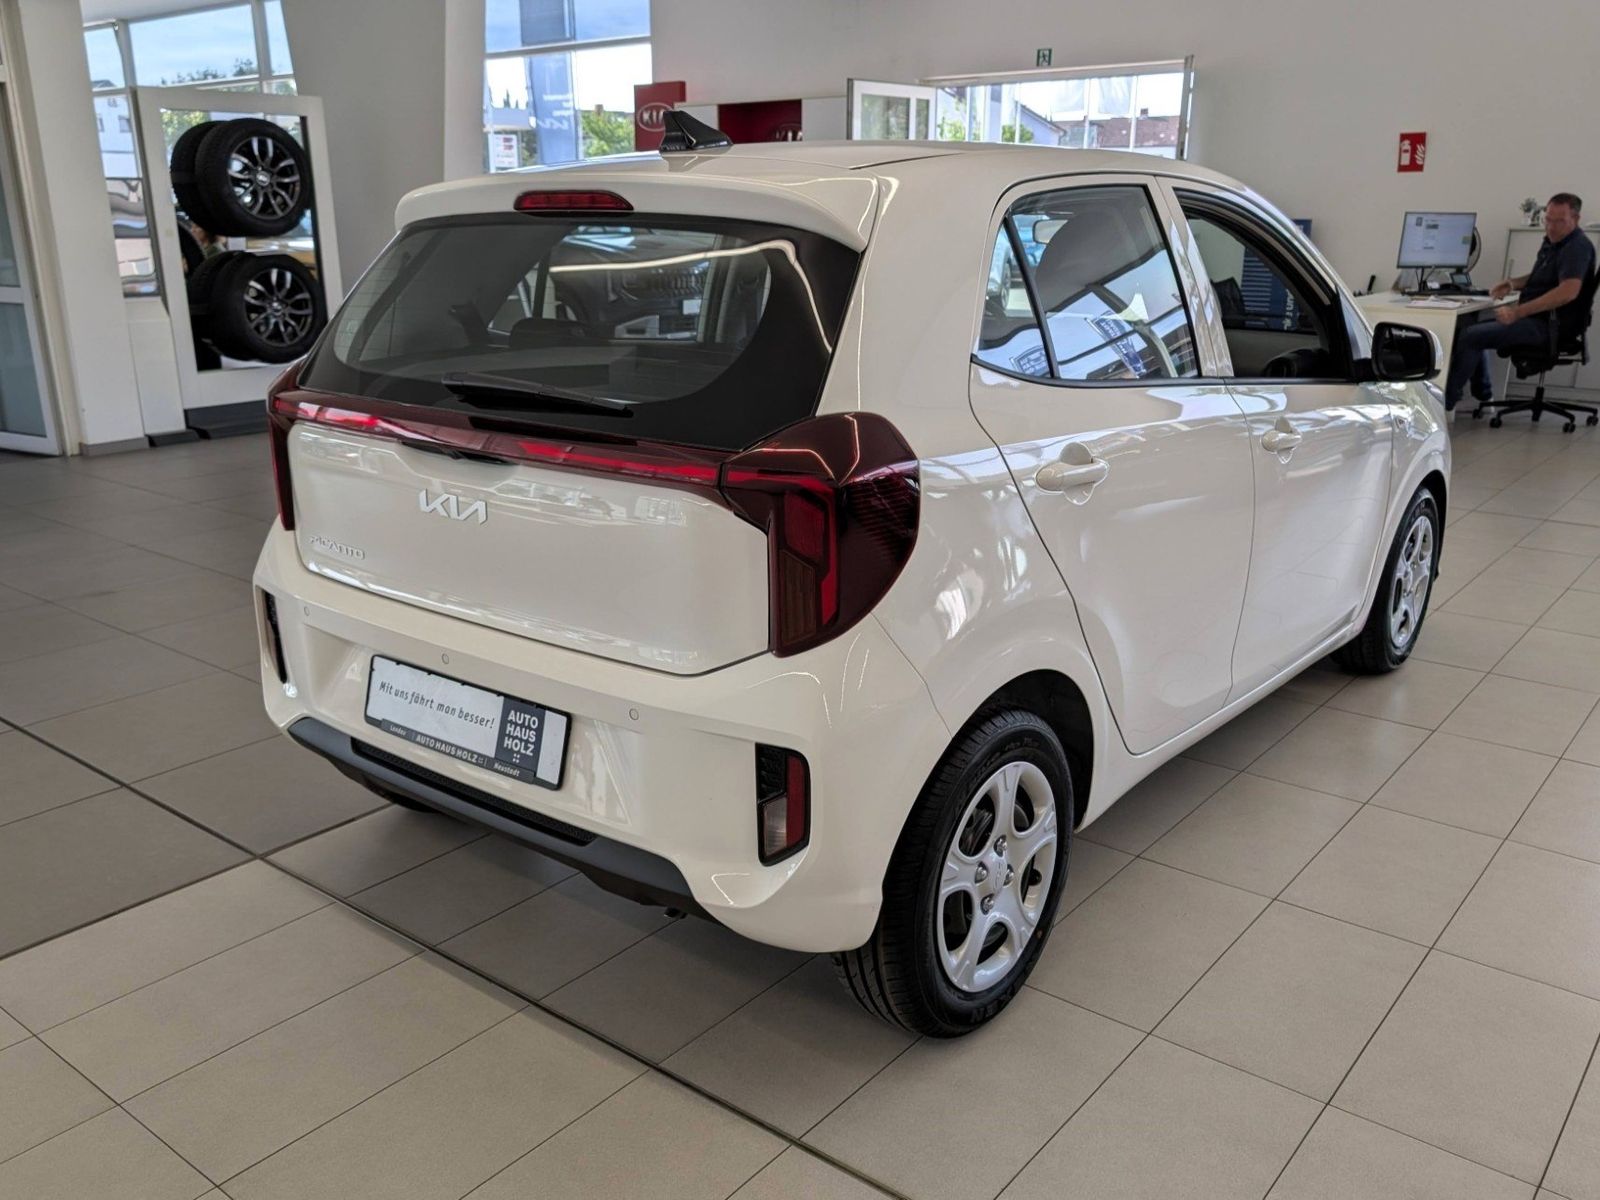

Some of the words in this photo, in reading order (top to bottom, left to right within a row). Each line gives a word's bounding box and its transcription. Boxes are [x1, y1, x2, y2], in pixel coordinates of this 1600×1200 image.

[418, 488, 488, 525] KIA
[380, 681, 393, 694] Mit
[394, 689, 409, 701] uns
[409, 692, 434, 709] fährt
[437, 702, 456, 715] man
[459, 707, 495, 728] besser!
[507, 709, 539, 729] AUTO
[505, 723, 536, 743] HAUS
[416, 734, 435, 749] AUTO
[435, 740, 457, 756] HAUS
[457, 748, 479, 763] HOLZ
[503, 736, 534, 756] HOLZ
